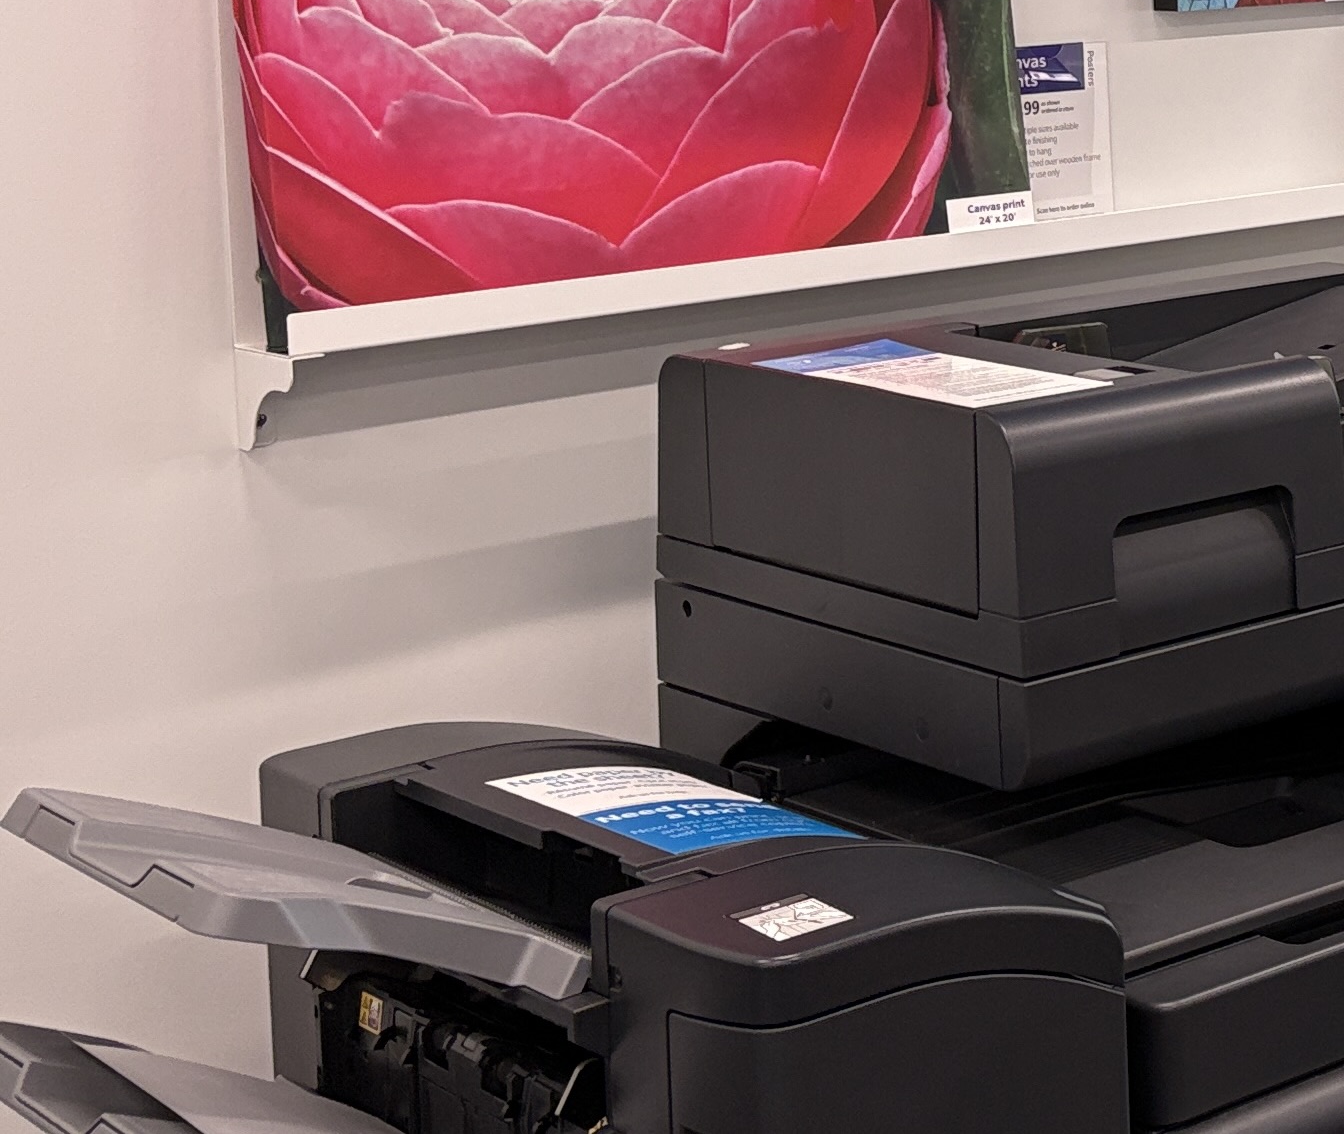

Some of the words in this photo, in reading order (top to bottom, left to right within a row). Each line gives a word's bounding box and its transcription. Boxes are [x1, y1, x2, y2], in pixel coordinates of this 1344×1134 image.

[967, 203, 1001, 214] Canvas
[1002, 199, 1026, 212] print
[995, 214, 1001, 222] x
[506, 772, 574, 788] Need
[594, 805, 677, 824] Need
[677, 802, 711, 811] to
[665, 812, 686, 820] a
